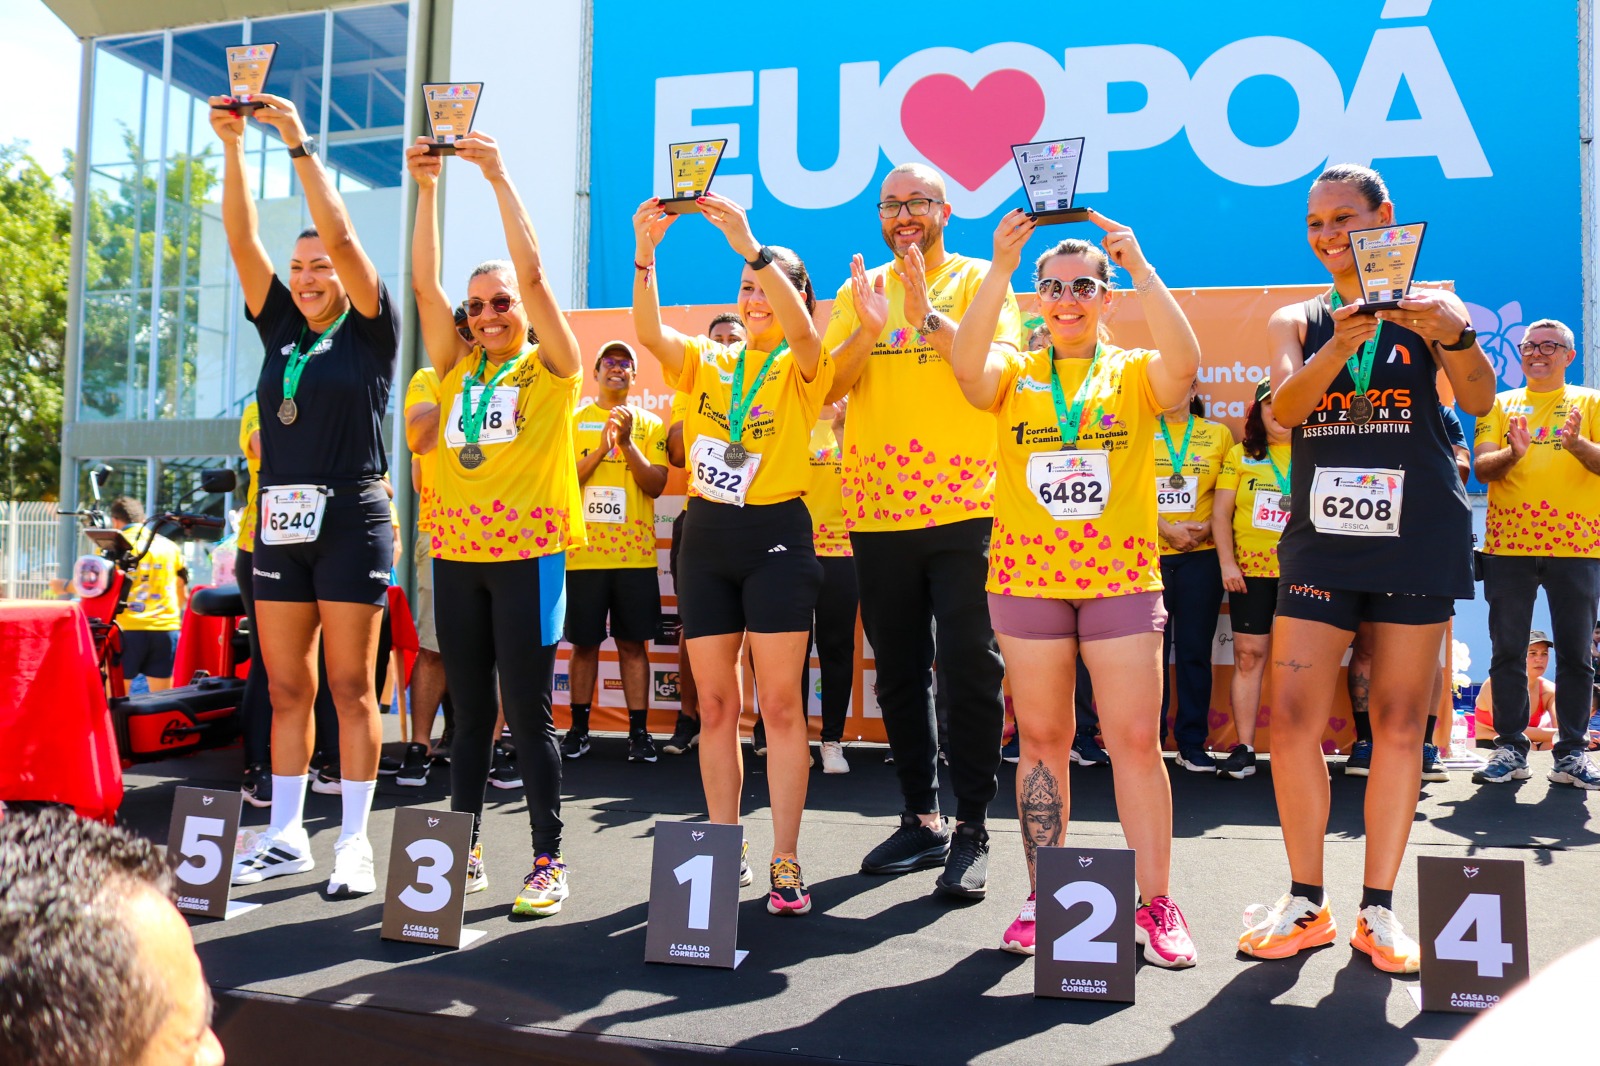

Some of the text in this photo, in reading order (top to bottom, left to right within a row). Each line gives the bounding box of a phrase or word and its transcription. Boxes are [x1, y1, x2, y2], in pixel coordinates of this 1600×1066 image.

[1197, 361, 1271, 383] unto
[1302, 408, 1411, 425] UZNO
[1026, 426, 1058, 436] Corrida
[1096, 430, 1128, 438] Inclusão
[1303, 424, 1410, 438] ASSESSORIA ESPORTIVA
[698, 462, 742, 493] 6322
[1040, 481, 1103, 504] 6482
[1158, 492, 1191, 504] 6510
[588, 502, 621, 514] 6506
[1322, 496, 1392, 521] 6208
[270, 512, 316, 530] 6240
[1340, 522, 1370, 530] JESSICA
[1290, 584, 1330, 598] runners
[176, 816, 225, 886] 5
[398, 838, 454, 912] 3
[672, 854, 714, 930] 1
[1053, 880, 1117, 964] 2
[402, 930, 439, 940] CORREDOR
[1434, 893, 1513, 978] 4
[669, 950, 710, 958] CORREDOR
[1070, 978, 1092, 986] CASA
[1061, 985, 1108, 994] CORREDOR
[1460, 993, 1484, 1002] CASA
